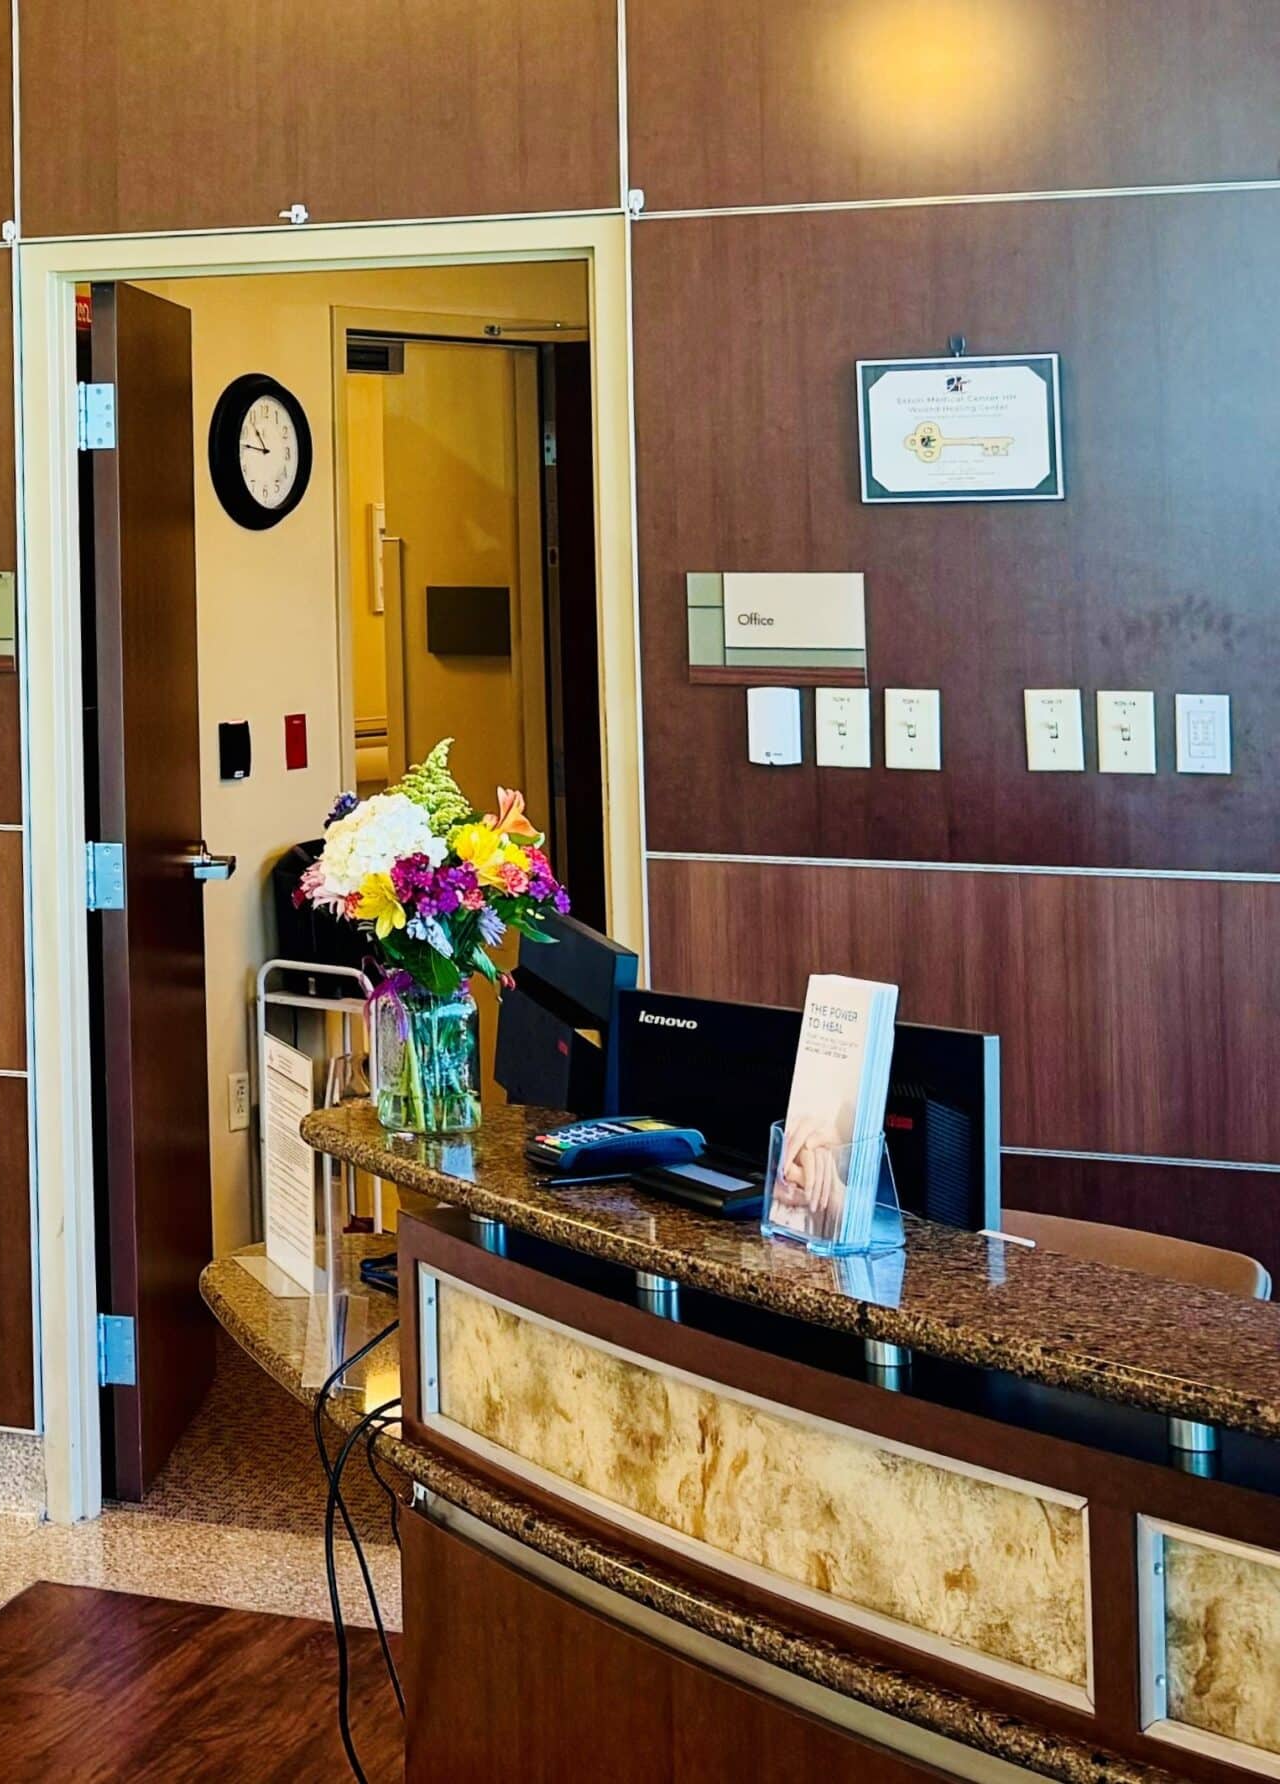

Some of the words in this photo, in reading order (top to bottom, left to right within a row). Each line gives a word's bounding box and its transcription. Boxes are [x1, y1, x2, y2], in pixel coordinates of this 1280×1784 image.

[260, 405, 269, 419] 12
[737, 612, 775, 627] Office
[638, 1010, 698, 1030] lenovo
[810, 1002, 828, 1017] THE
[830, 1007, 858, 1023] POWER
[808, 1016, 821, 1029] TO
[822, 1020, 844, 1034] HEAL
